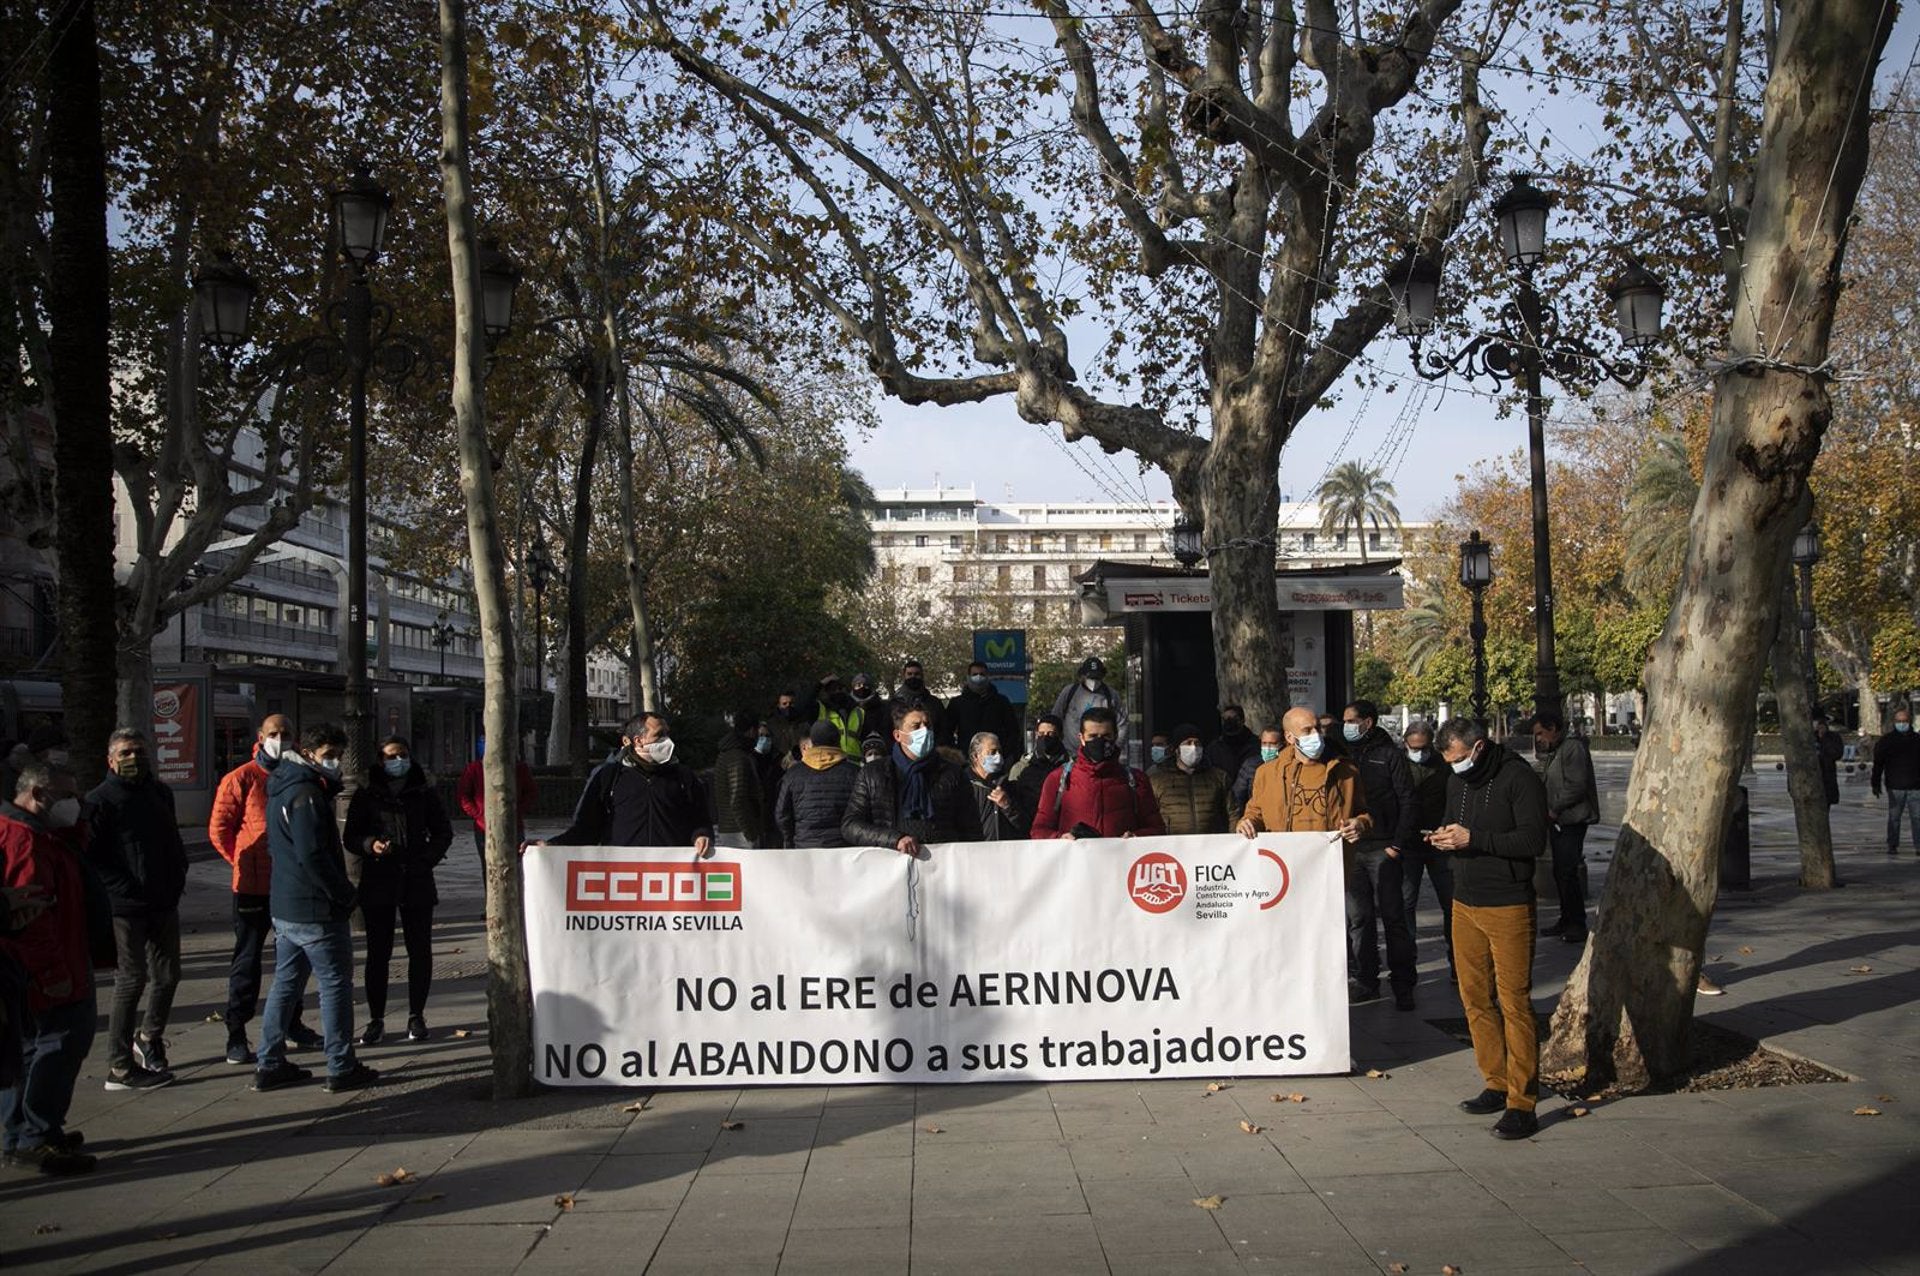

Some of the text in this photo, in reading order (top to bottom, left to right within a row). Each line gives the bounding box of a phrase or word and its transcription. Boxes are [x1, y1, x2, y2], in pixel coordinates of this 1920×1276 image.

[1170, 593, 1210, 604] Tickets
[1135, 863, 1178, 886] UGT
[1195, 864, 1236, 882] FICA
[577, 872, 702, 901] CCOO
[1196, 884, 1230, 892] Industria,
[1245, 891, 1250, 899] y
[1252, 889, 1270, 899] Agro
[566, 915, 743, 931] INDUSTRIA SEVILLA
[1196, 910, 1228, 919] Sevilla
[676, 967, 1180, 1012] NO al ERE de AERNNOVA
[546, 1027, 1307, 1079] NO al ABANDONO a sus trabajadores
